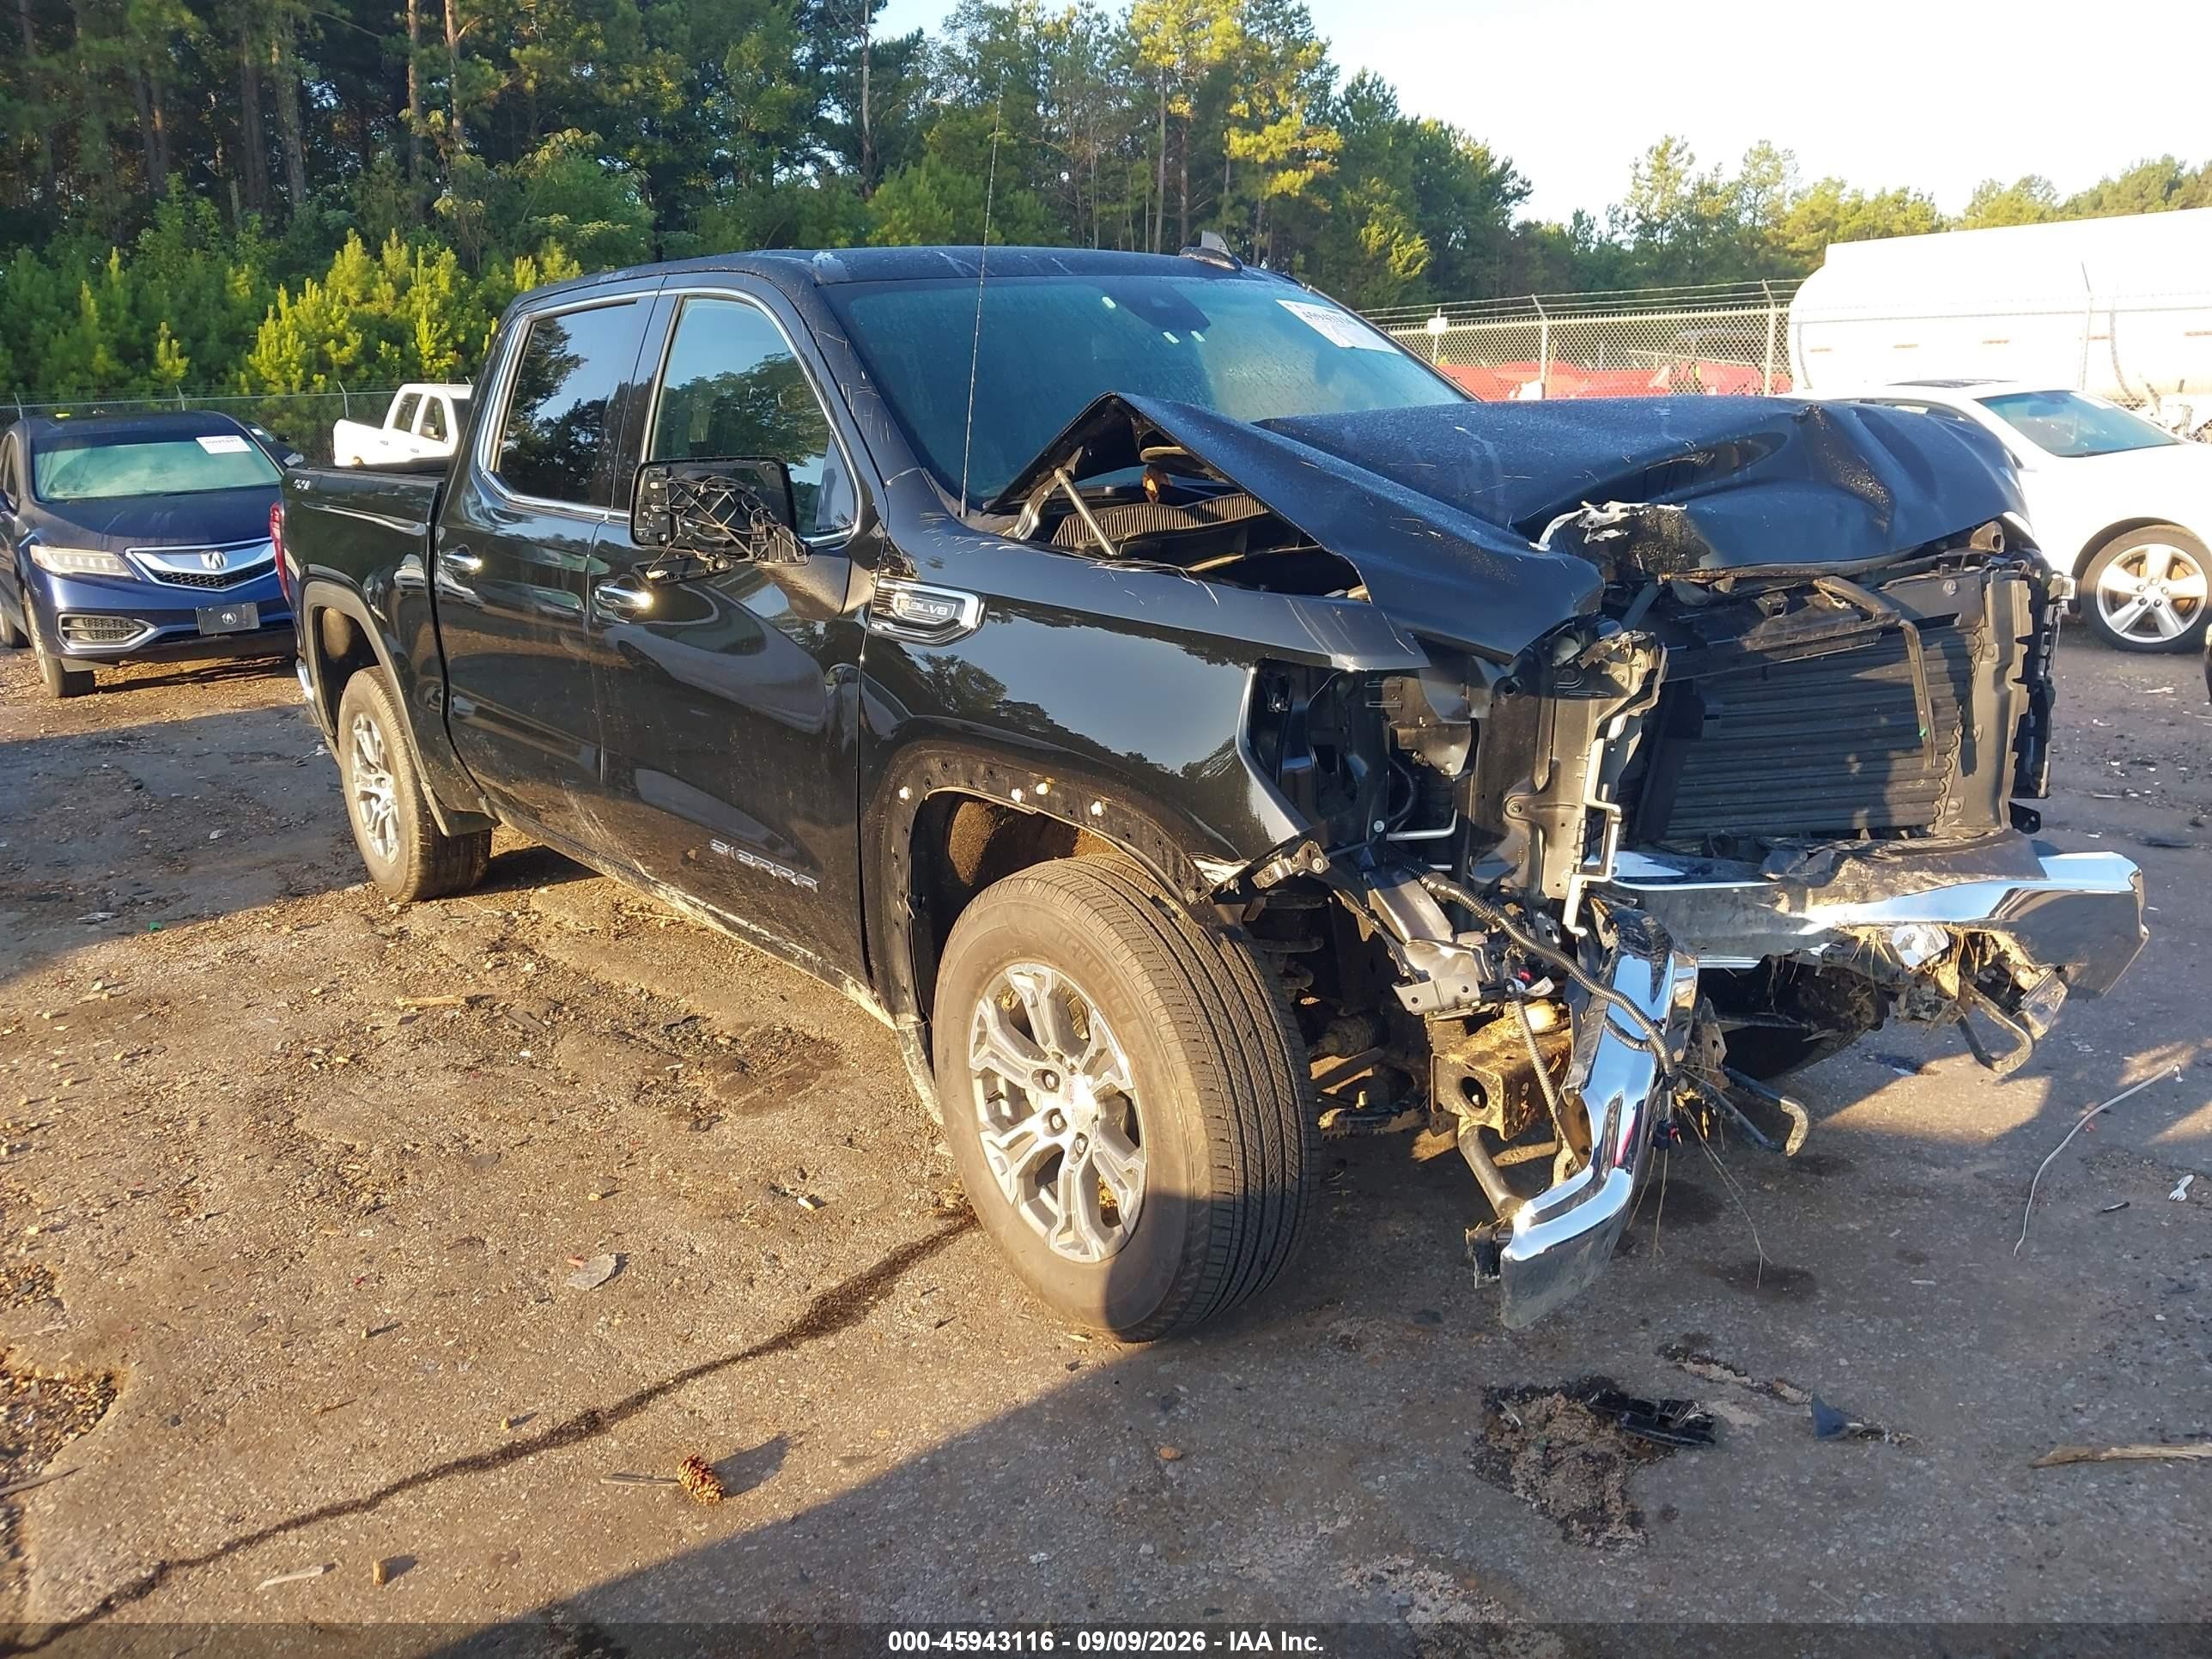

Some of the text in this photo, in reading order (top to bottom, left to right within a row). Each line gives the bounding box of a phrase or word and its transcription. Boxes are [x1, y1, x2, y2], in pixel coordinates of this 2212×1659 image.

[928, 604, 949, 616] V8
[709, 838, 819, 894] SIERRA
[1037, 919, 1134, 1021] ICHELIN
